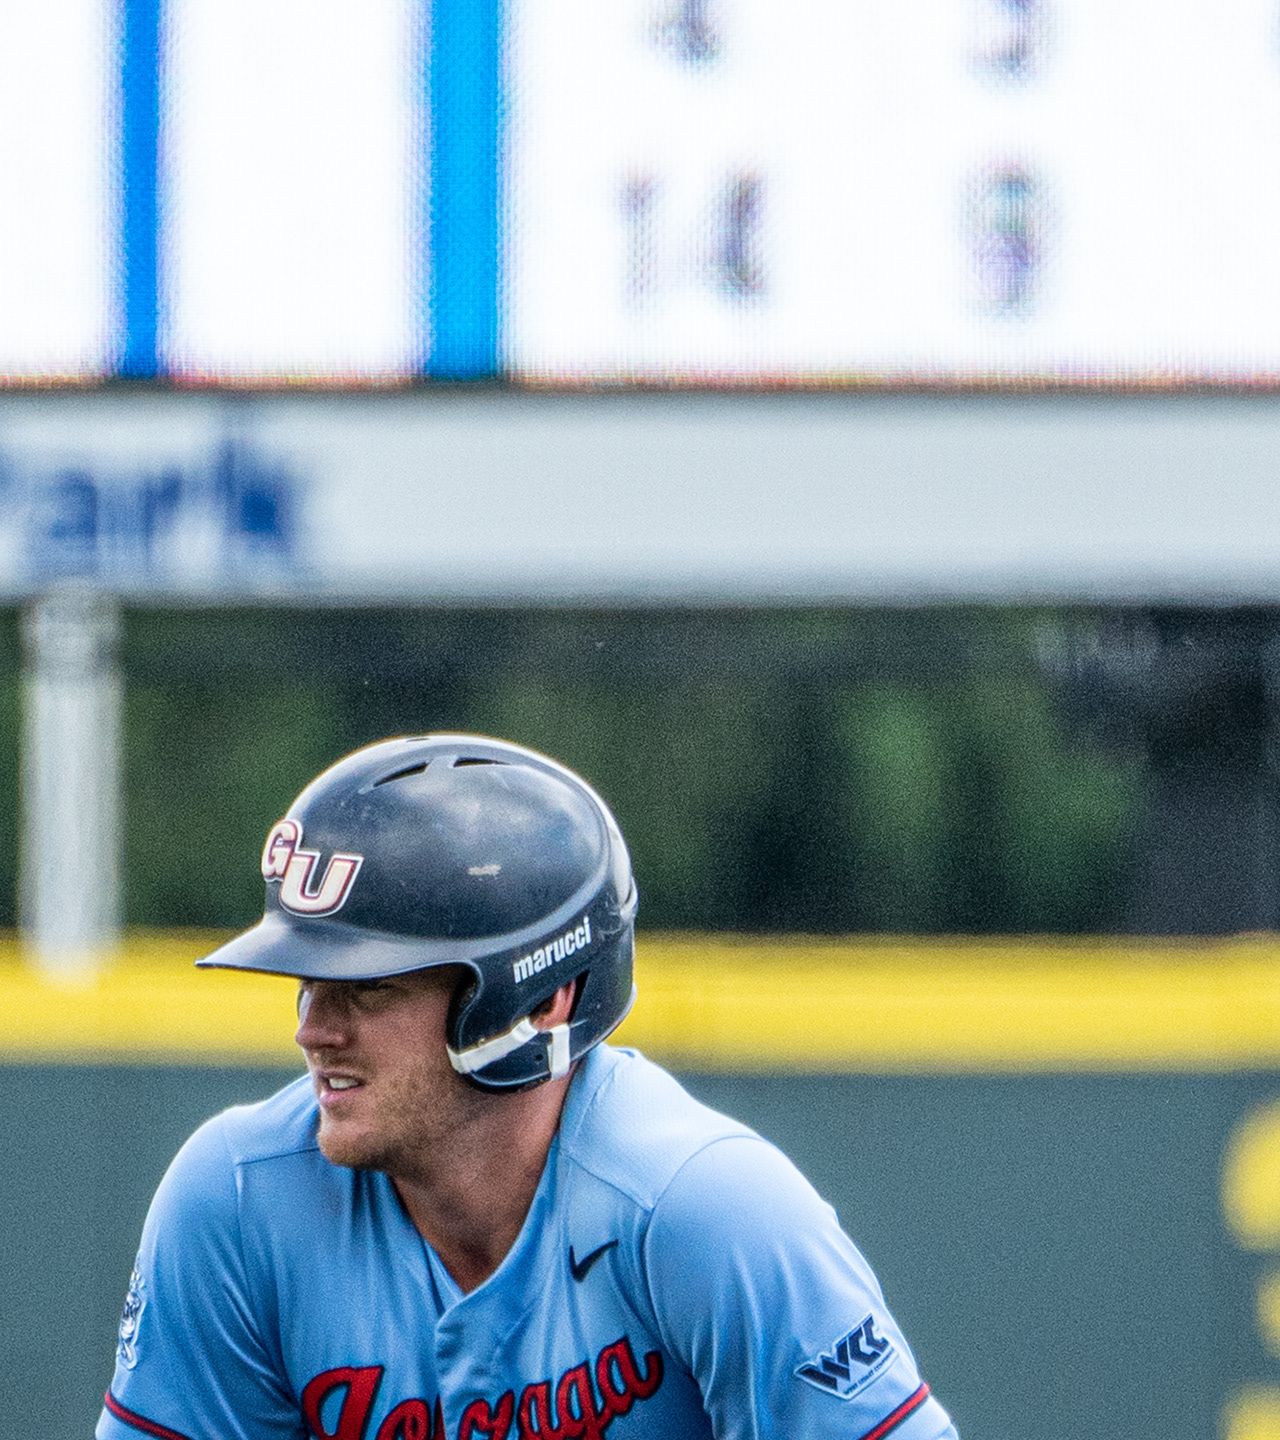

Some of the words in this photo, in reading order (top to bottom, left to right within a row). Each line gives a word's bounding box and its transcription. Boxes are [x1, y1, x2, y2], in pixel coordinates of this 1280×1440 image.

[261, 819, 364, 917] GU
[513, 915, 592, 984] marucci
[799, 1315, 889, 1392] WCC
